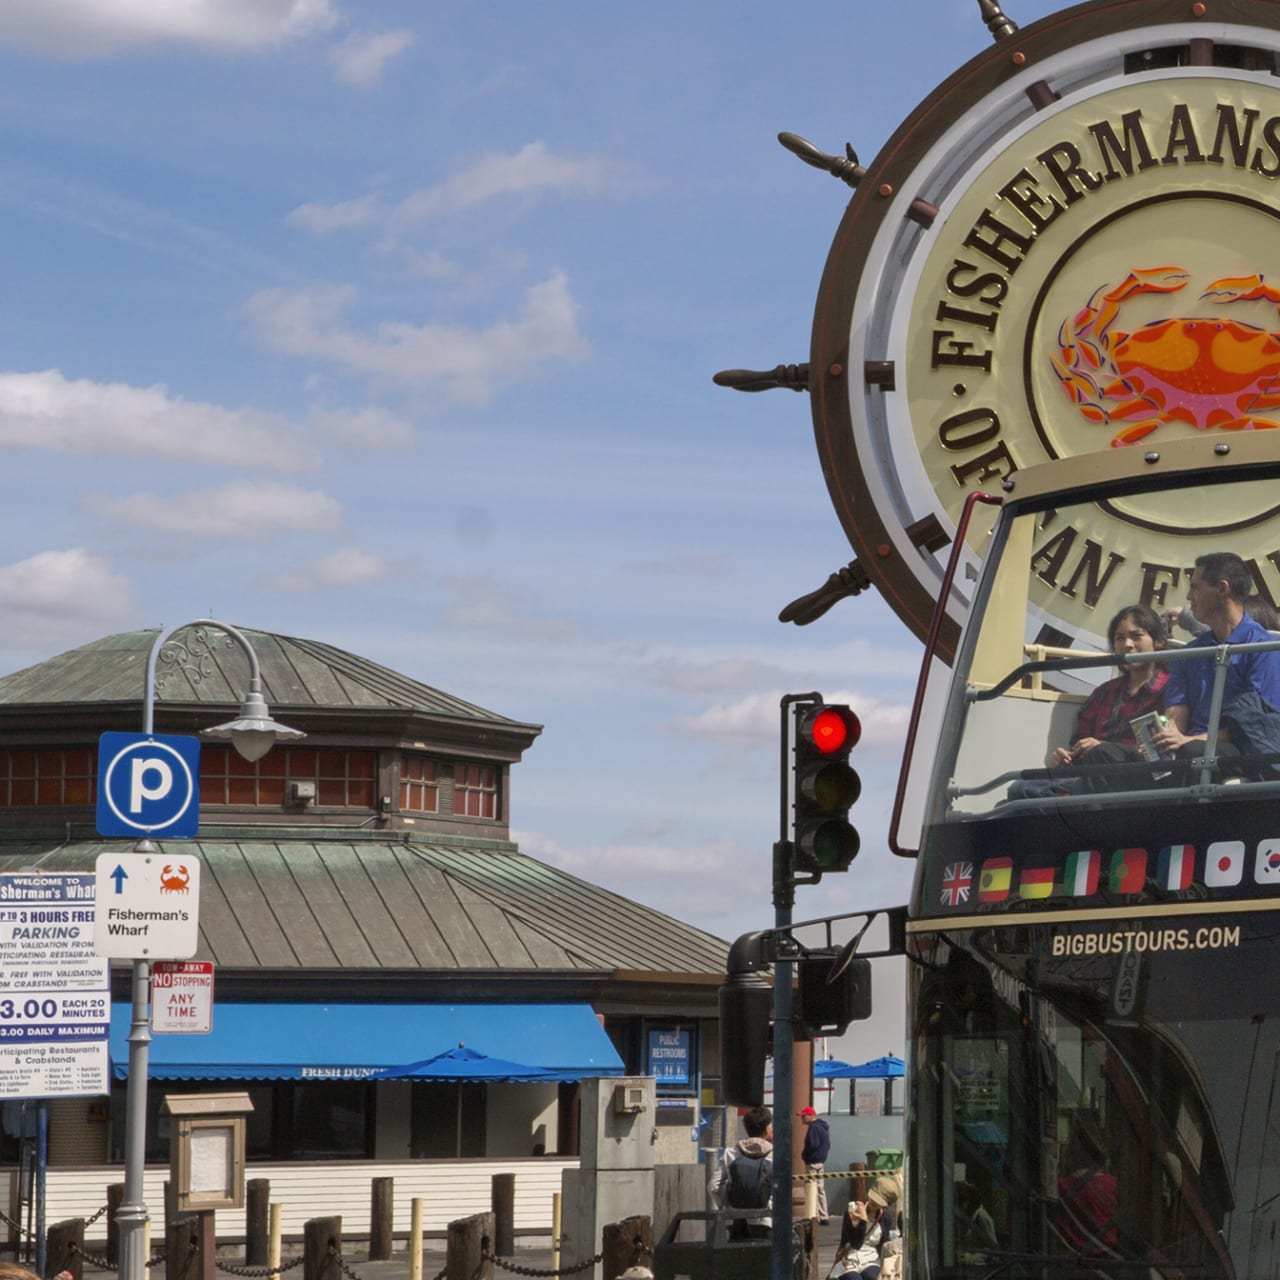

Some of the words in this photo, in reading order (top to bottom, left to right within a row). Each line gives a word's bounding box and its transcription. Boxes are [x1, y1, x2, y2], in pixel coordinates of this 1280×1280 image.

[938, 407, 1019, 490] OF
[1030, 508, 1127, 611] AN
[8, 911, 18, 920] TO
[20, 911, 28, 923] 3
[30, 910, 69, 923] HOURS
[108, 908, 189, 921] Fisherman's
[11, 926, 80, 939] PARKING
[108, 924, 149, 936] Wharf
[21, 941, 69, 949] VALIDATION
[1052, 926, 1241, 957] BIGBUSTOURS.COM
[50, 951, 97, 959] RESTAURAN
[163, 963, 205, 973] TOW-AWAY
[32, 970, 52, 978] WITH
[14, 980, 68, 988] CRABSTANDS
[154, 973, 171, 987] NO
[173, 976, 211, 988] STOPPING
[62, 999, 88, 1008] EACH
[90, 999, 105, 1007] 20
[169, 993, 196, 1004] ANY
[62, 1009, 106, 1018] MINUTES
[167, 1006, 197, 1018] TIME
[27, 1027, 55, 1036] DAILY
[58, 1026, 106, 1036] MAXIMUM
[659, 1034, 680, 1046] PUBLIC
[49, 1046, 100, 1055] Restaurants
[652, 1047, 687, 1059] RESTROOMS
[25, 1056, 76, 1065] Crabstands
[302, 1067, 341, 1078] FRESH
